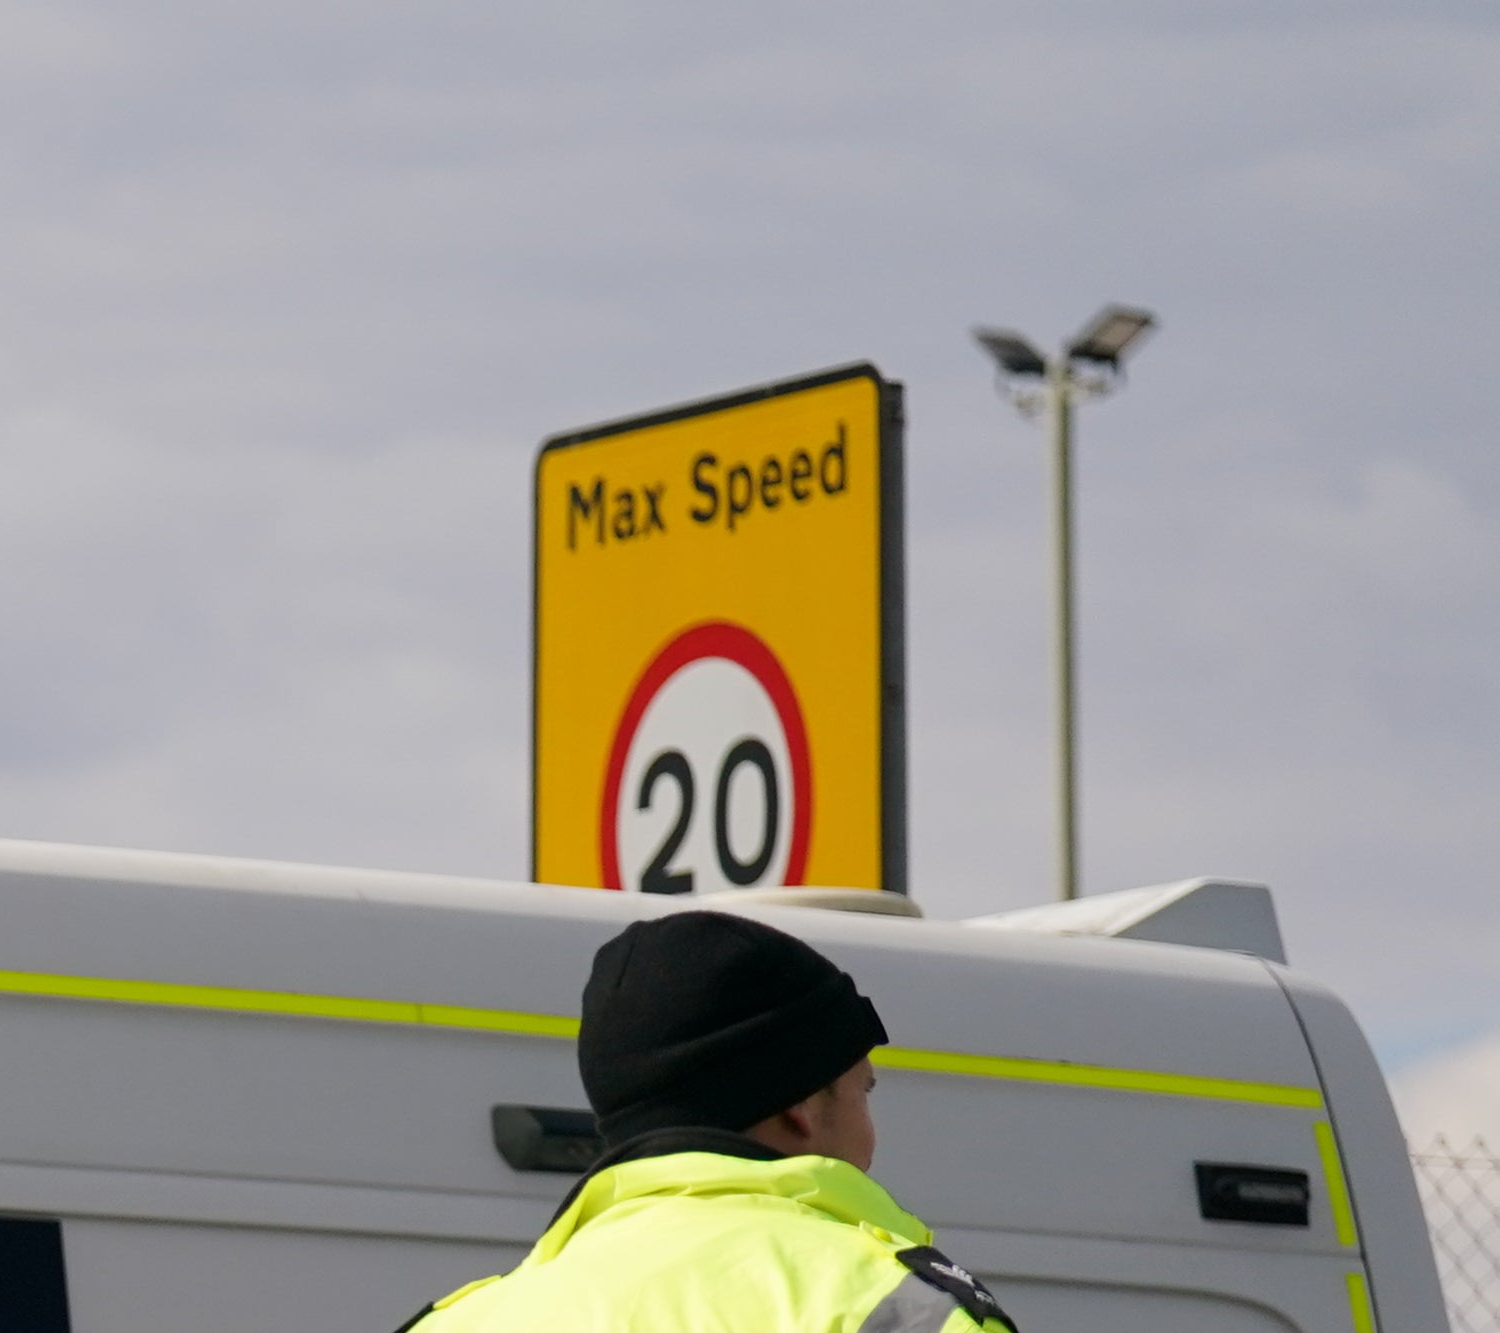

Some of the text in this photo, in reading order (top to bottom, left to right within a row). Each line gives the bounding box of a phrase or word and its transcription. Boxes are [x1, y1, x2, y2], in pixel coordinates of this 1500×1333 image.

[567, 420, 847, 552] Max Speed
[638, 738, 778, 895] 20
